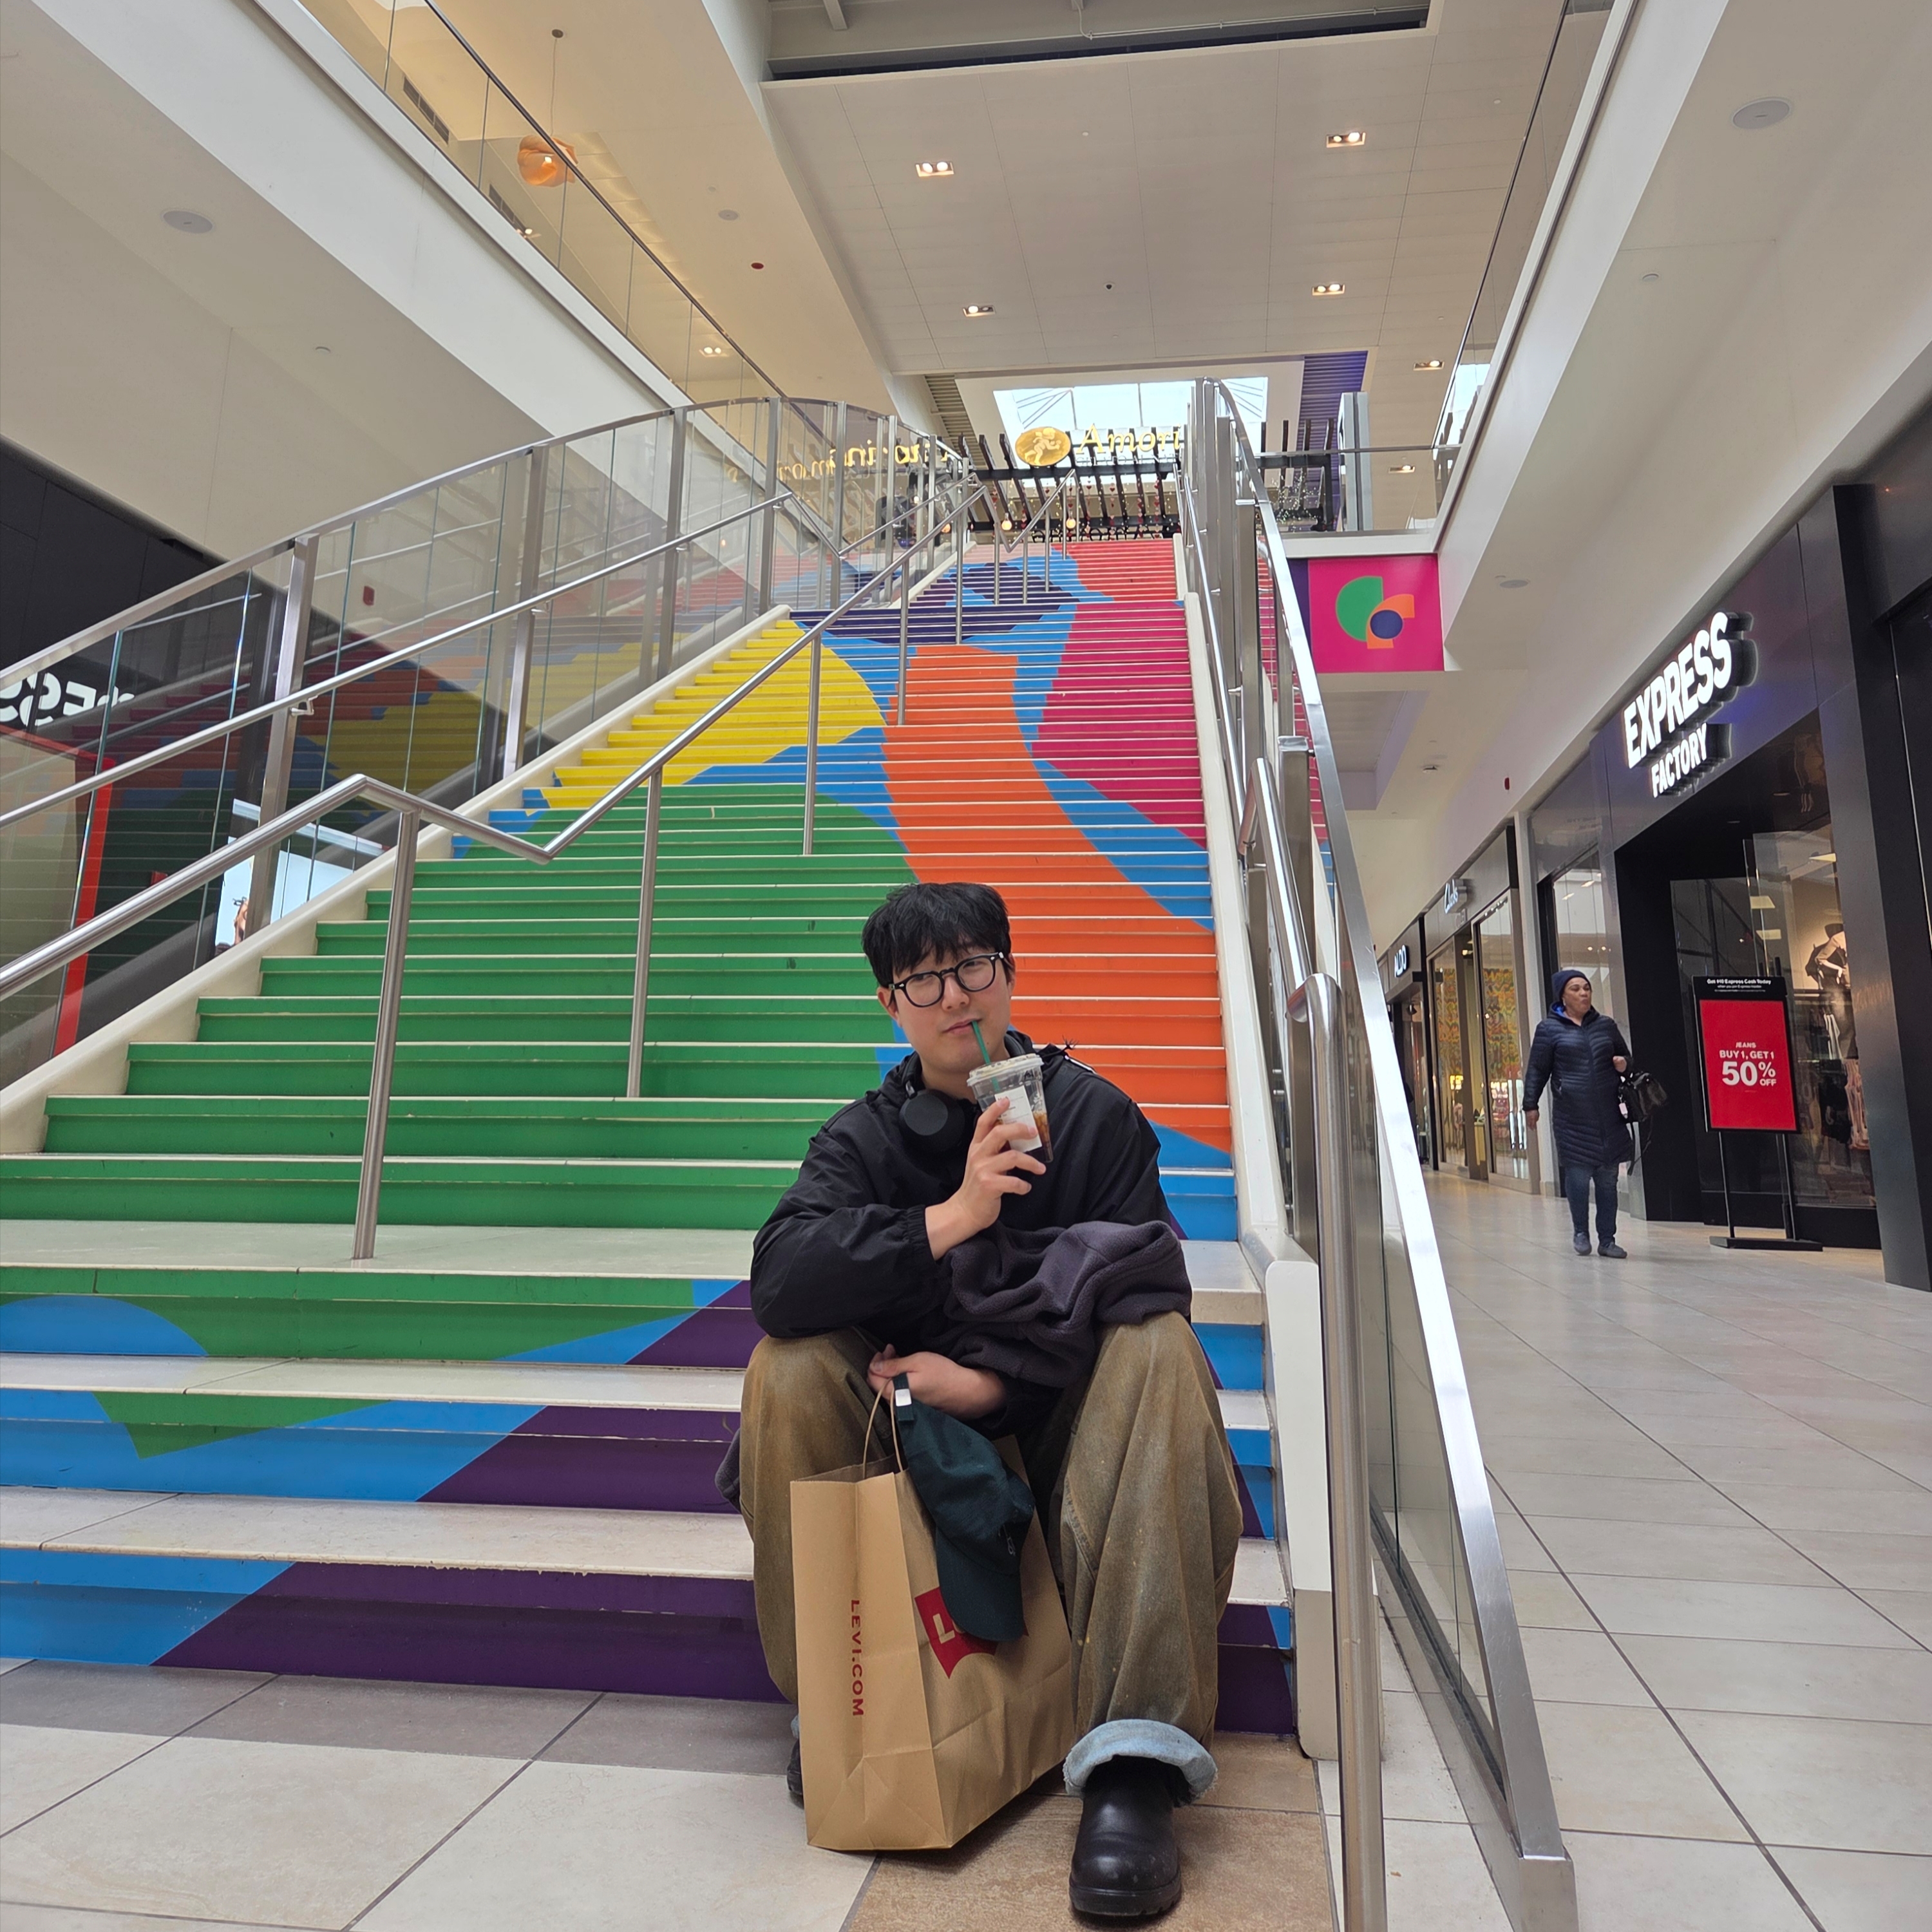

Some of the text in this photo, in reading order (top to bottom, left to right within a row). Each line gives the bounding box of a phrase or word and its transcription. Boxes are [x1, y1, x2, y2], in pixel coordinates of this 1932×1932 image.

[1624, 612, 1732, 769] EXPRESS
[1651, 723, 1707, 798] FACTORY
[1719, 1050, 1774, 1060] BUY 1, GET 1
[851, 1600, 864, 1716] LEVI.COM
